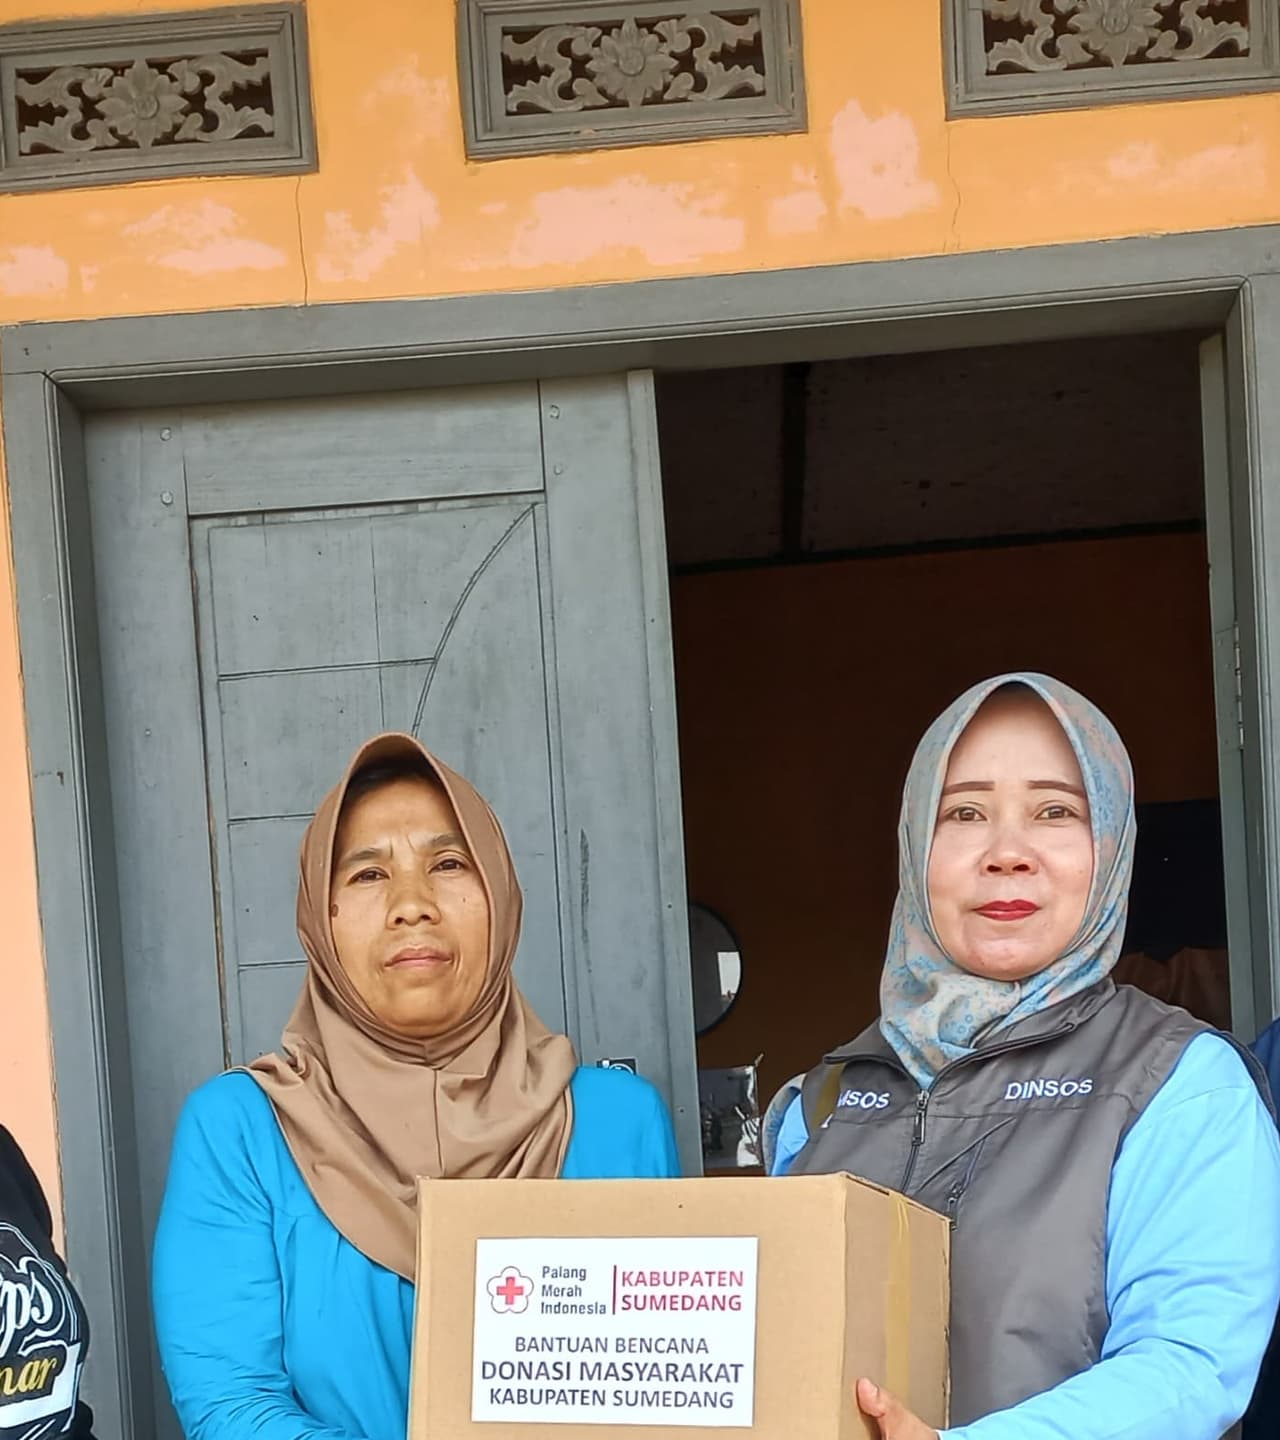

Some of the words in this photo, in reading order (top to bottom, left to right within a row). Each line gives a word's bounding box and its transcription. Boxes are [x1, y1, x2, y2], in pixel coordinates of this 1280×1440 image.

[1004, 1078, 1094, 1101] DINSOS
[541, 1264, 587, 1282] Palang
[621, 1269, 744, 1289] KABUPATEN
[541, 1283, 582, 1298] Merah
[540, 1301, 606, 1316] Indonesia
[621, 1293, 742, 1313] SUMEDANG
[514, 1335, 608, 1353] BANTUAN
[614, 1337, 709, 1355] BENCANA
[481, 1359, 572, 1381] DONASI
[579, 1361, 744, 1384] MASYARAKAT
[489, 1386, 606, 1406] KABUPATEN
[612, 1388, 734, 1409] SUMEDANG
